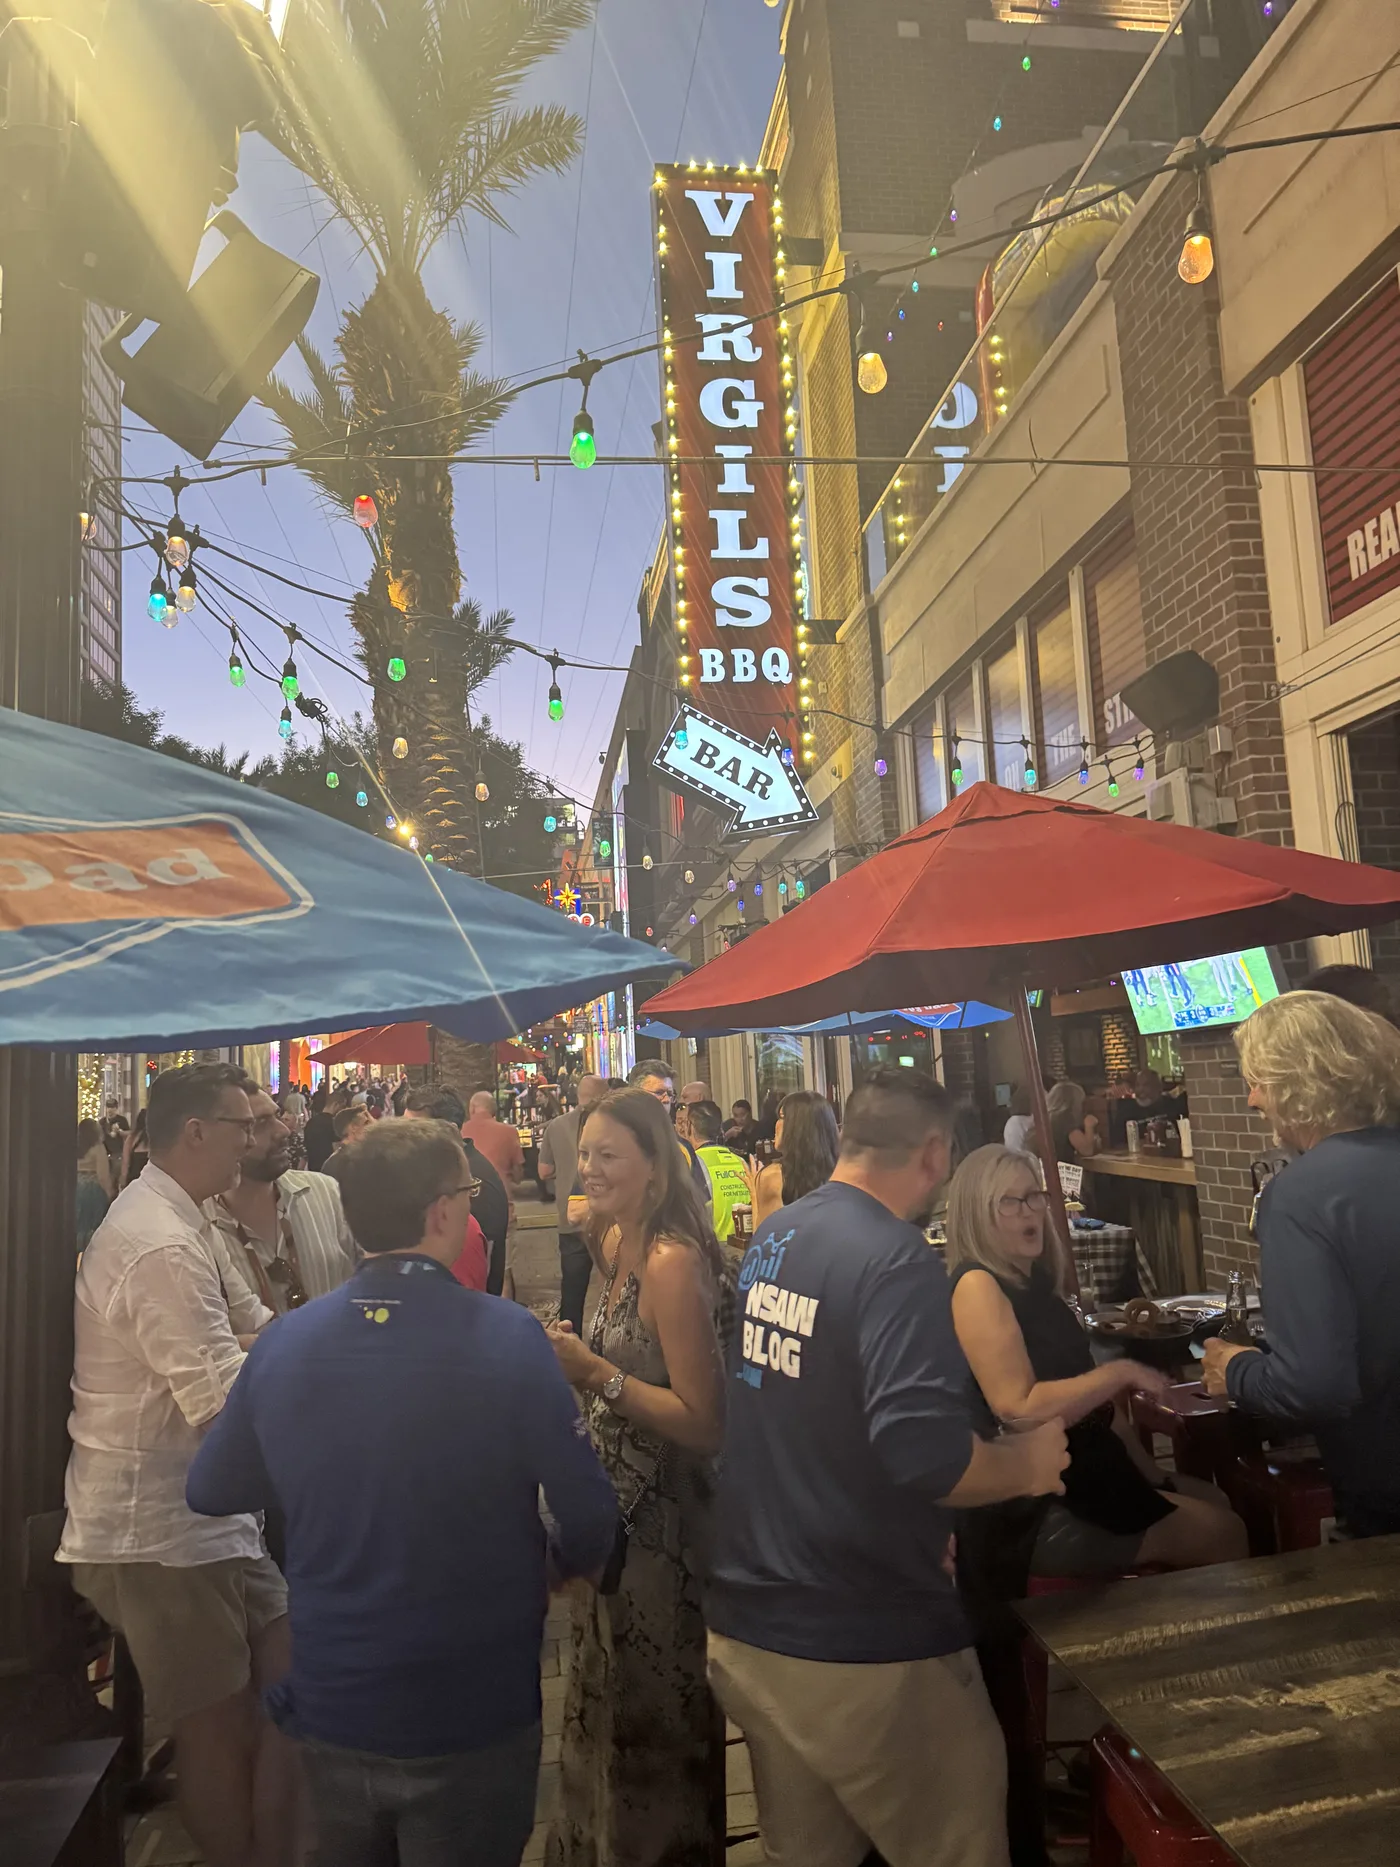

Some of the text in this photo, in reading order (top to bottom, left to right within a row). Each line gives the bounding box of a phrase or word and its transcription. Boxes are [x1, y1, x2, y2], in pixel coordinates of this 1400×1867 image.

[685, 190, 772, 627] VIRGILS
[698, 647, 793, 684] BBQ
[690, 739, 775, 801] BAR
[1051, 723, 1077, 766] THE
[744, 1281, 820, 1337] NSAW
[742, 1320, 802, 1379] BLOG
